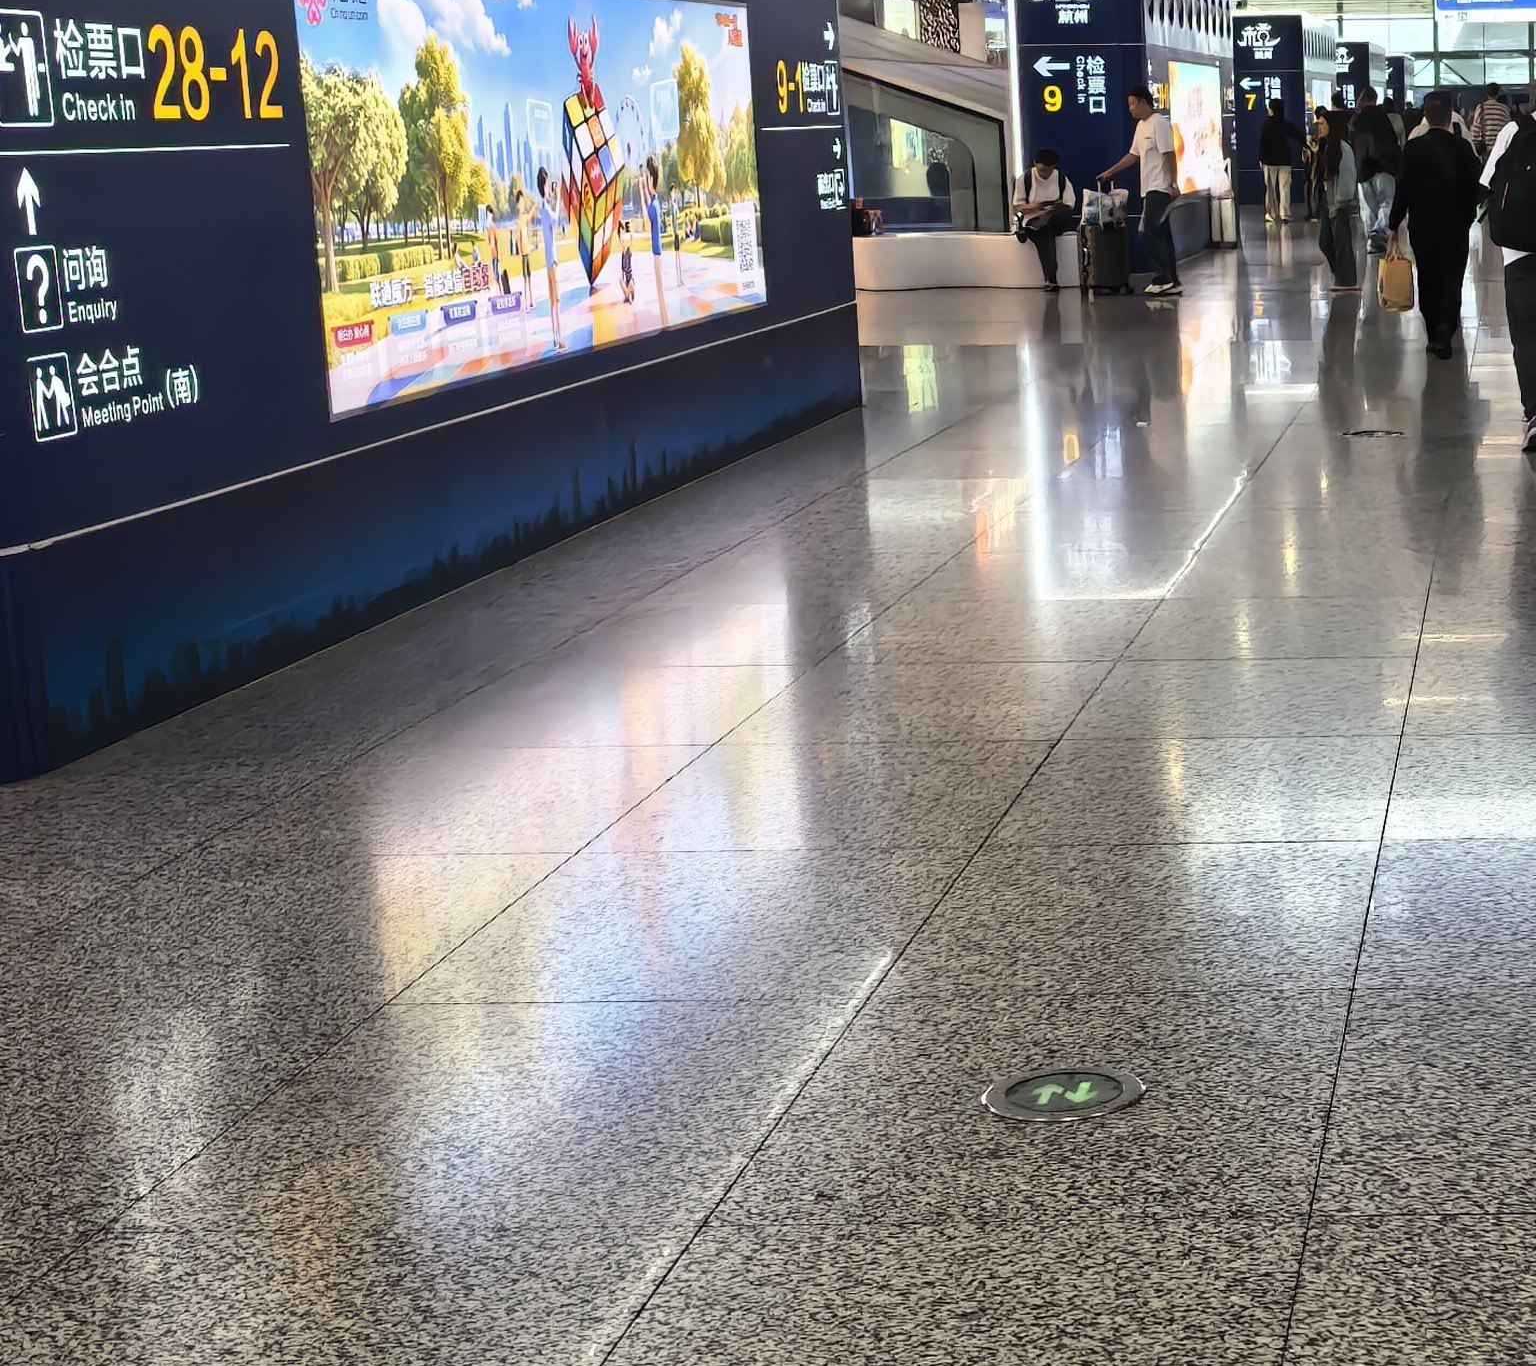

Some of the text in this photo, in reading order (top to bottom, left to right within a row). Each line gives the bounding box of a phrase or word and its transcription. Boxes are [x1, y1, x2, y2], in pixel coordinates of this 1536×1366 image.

[53, 18, 284, 122] 检票口 28-12
[776, 59, 804, 114] 9-1
[1086, 55, 1106, 114] 检票口
[62, 92, 137, 122] Check in
[1043, 85, 1063, 112] 9
[1245, 94, 1257, 111] 7
[62, 245, 109, 292] 问询
[67, 298, 118, 324] Enquiry
[76, 344, 143, 396] 会合点
[81, 391, 165, 428] Meeting Point
